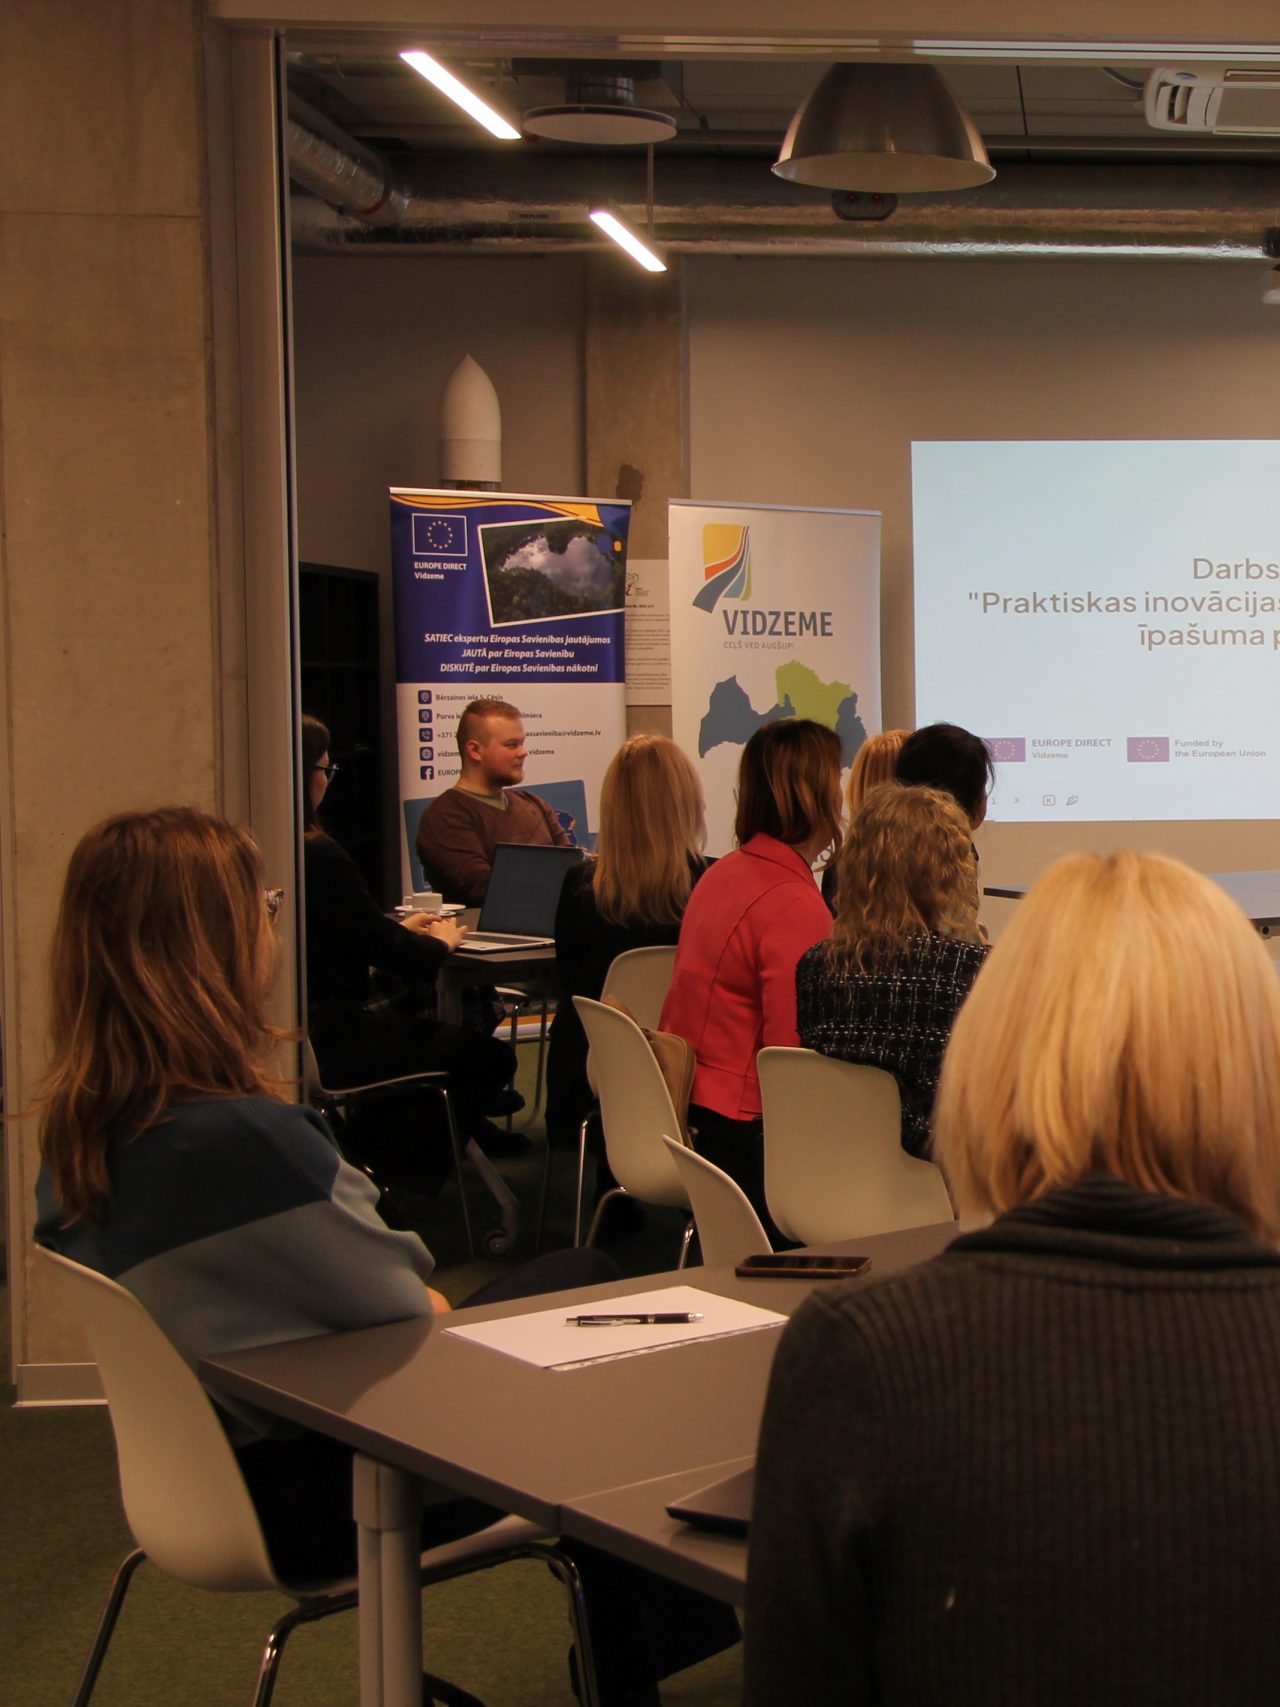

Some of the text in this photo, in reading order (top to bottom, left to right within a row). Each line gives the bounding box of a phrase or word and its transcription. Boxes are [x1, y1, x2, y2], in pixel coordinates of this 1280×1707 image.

[414, 561, 467, 571] EUROPE DIRECT
[414, 572, 444, 580] Vidzeme
[968, 591, 1137, 614] "Praktiskas
[722, 609, 833, 637] VIDZEME
[424, 633, 454, 643] SATIEC
[454, 633, 489, 645] ekspertu
[489, 634, 520, 645] Eiropas
[564, 635, 611, 646] jautājumos
[1137, 622, 1265, 651] īpašuma
[744, 641, 760, 649] VED
[462, 648, 487, 658] JAUTĀ
[488, 650, 503, 660] par
[503, 649, 534, 660] Eiropas
[440, 662, 475, 673] DISKUTĒ
[475, 665, 490, 675] par
[490, 663, 521, 675] Eiropas
[1032, 738, 1112, 747] EUROPE DIRECT
[1174, 739, 1223, 748] Funded by
[1032, 751, 1068, 759] Vidzeme
[1175, 749, 1267, 759] the European Union
